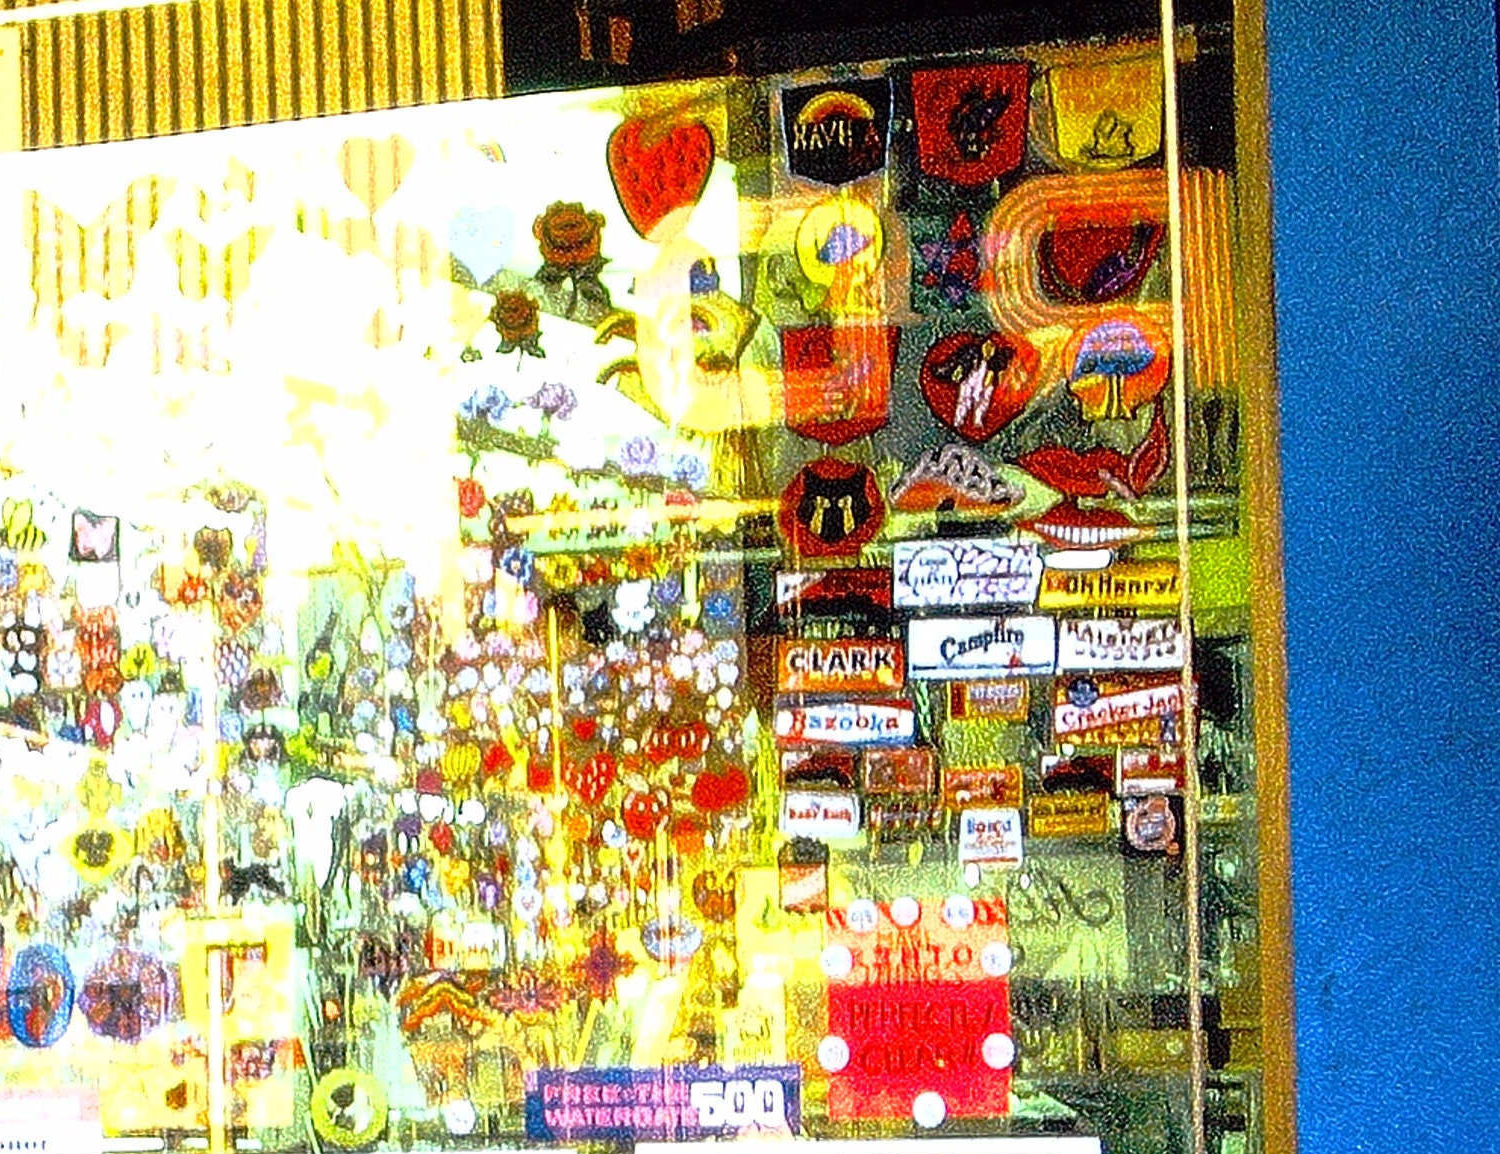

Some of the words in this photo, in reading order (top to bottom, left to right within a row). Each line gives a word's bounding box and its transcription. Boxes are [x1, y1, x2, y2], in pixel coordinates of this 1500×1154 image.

[787, 645, 896, 674] CLARK
[792, 708, 900, 739] Bazooka
[690, 1079, 786, 1127] 500
